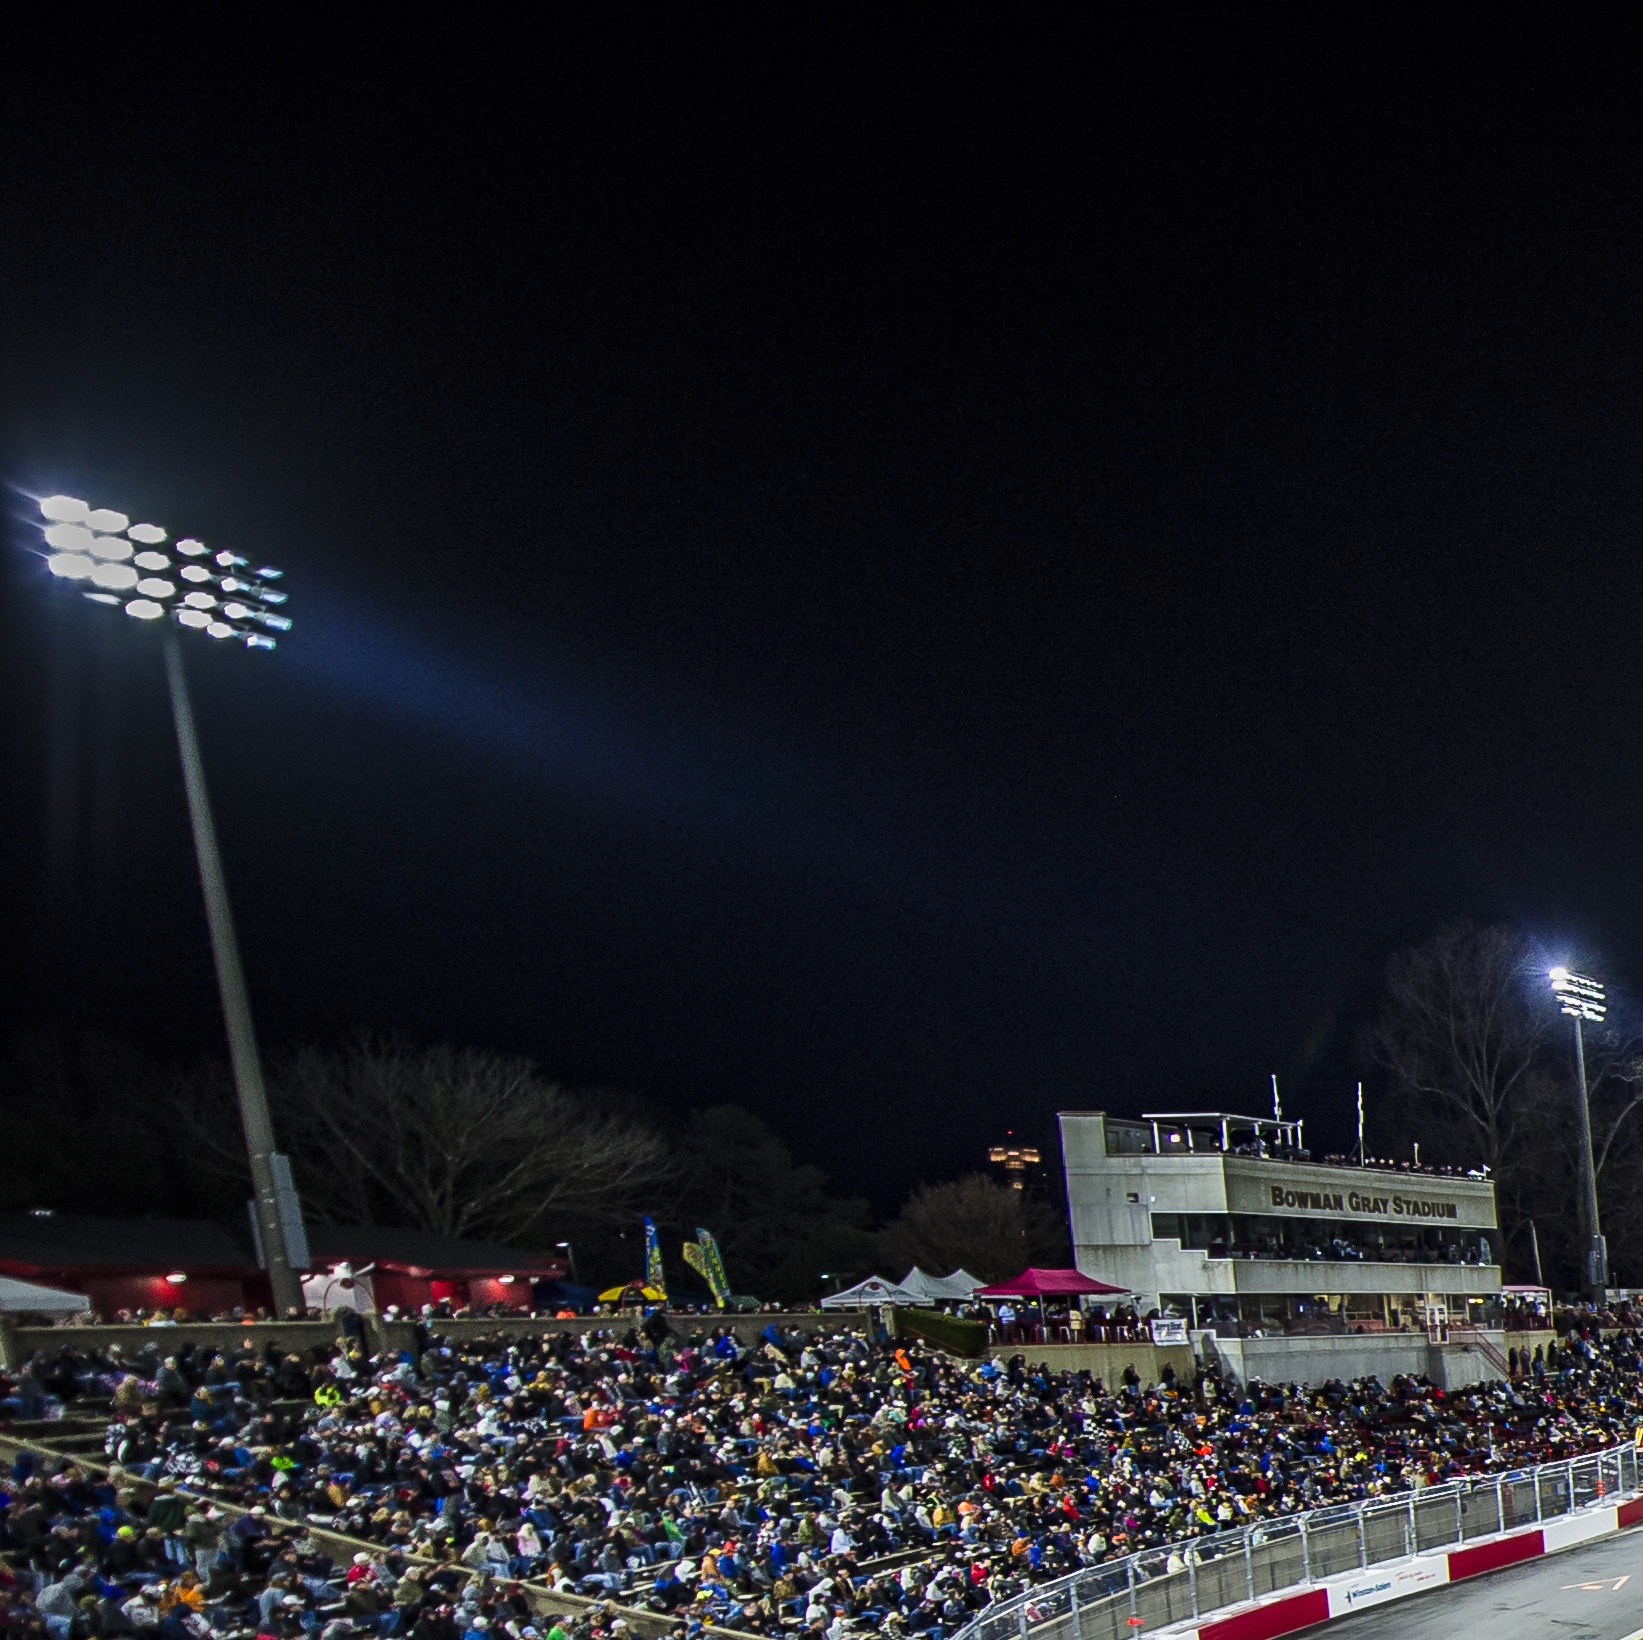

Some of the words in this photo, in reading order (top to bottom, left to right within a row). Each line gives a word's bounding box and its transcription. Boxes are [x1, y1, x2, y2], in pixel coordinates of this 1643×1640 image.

[1270, 1185, 1344, 1211] BOWMAN
[1348, 1191, 1390, 1215] GRAY
[1392, 1195, 1458, 1219] STADIUM
